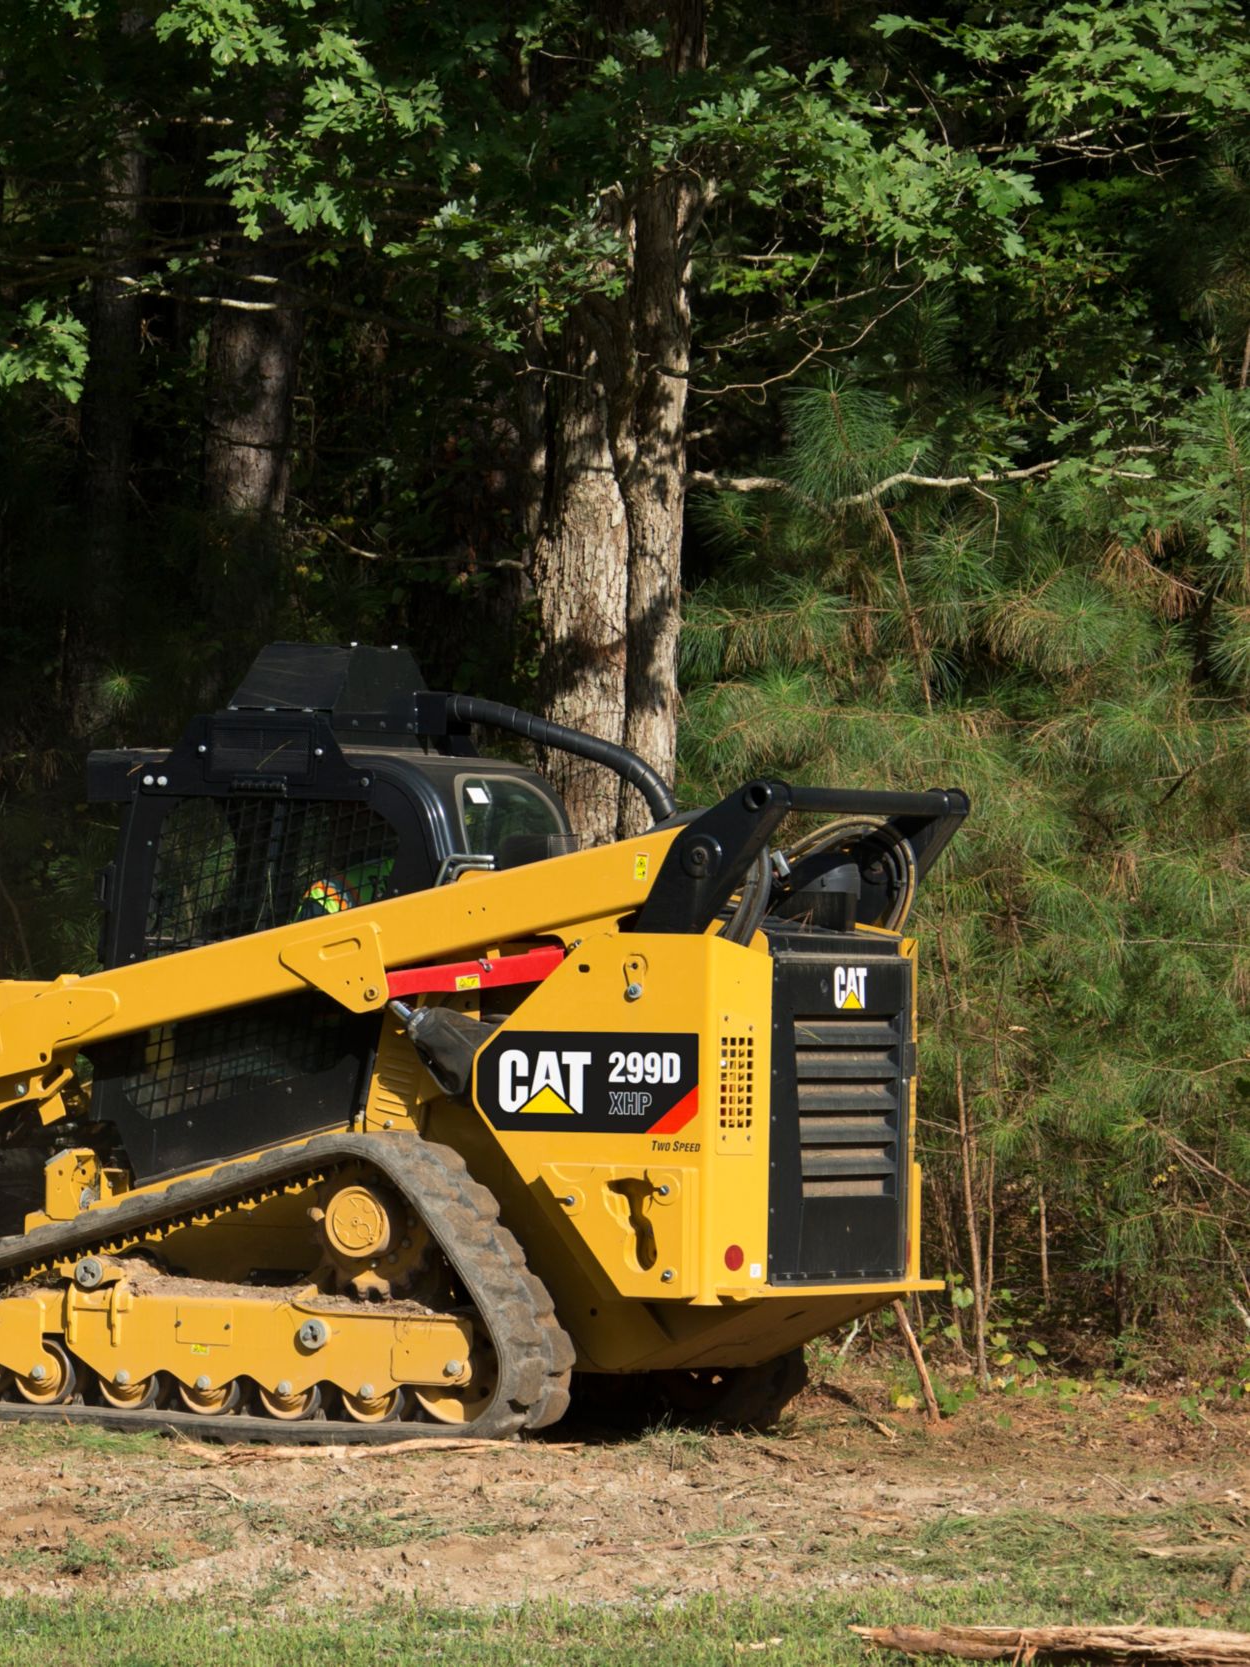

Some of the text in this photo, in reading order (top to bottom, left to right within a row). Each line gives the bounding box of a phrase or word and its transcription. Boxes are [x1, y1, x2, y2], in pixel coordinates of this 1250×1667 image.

[834, 966, 867, 1009] CAT
[498, 1049, 681, 1114] CAT 299D
[608, 1091, 652, 1116] XHP
